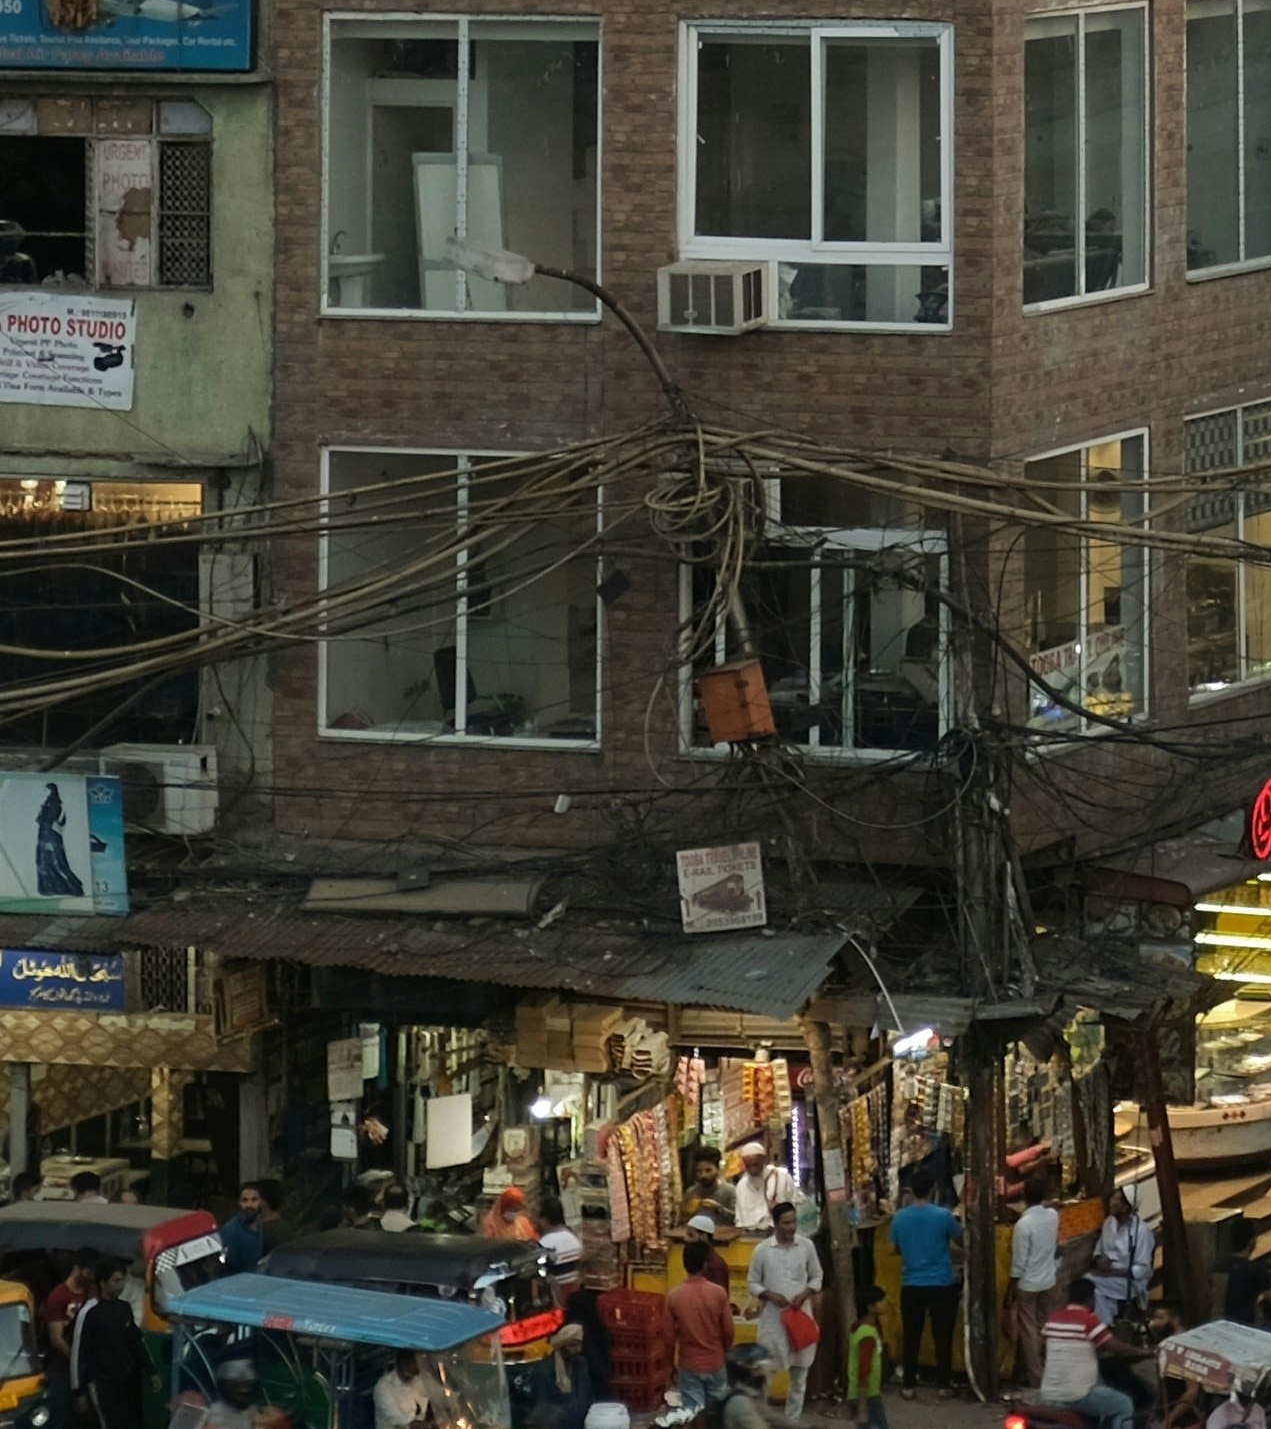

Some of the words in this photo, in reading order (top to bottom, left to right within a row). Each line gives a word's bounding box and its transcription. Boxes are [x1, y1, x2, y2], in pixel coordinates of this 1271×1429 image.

[103, 143, 147, 160] URGENT
[102, 173, 147, 190] PHOTO
[7, 314, 61, 336] PHOTO
[66, 318, 126, 340] STUDIO
